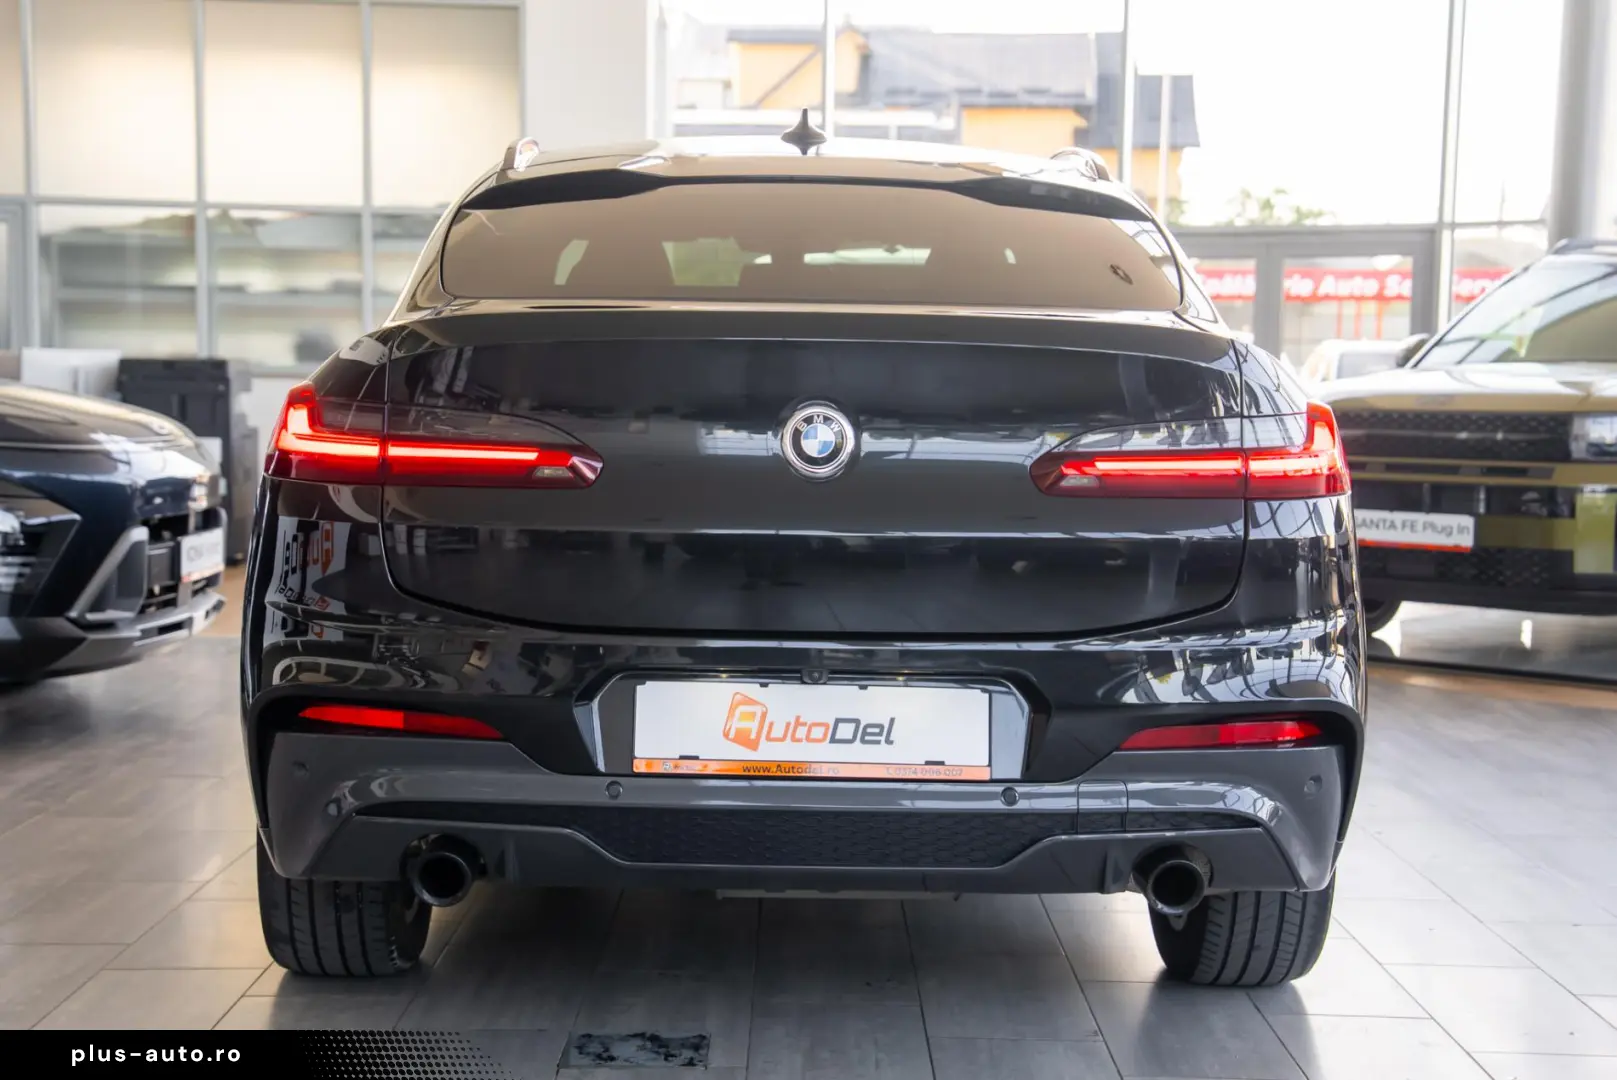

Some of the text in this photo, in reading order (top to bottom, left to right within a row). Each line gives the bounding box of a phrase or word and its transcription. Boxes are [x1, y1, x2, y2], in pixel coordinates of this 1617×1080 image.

[1317, 274, 1379, 297] Auto
[796, 414, 841, 432] BMW
[1400, 519, 1420, 533] FE
[1422, 521, 1454, 538] Plug
[1457, 522, 1470, 536] In
[725, 699, 896, 748] AutoDel
[741, 763, 840, 776] www.Autodel.ro
